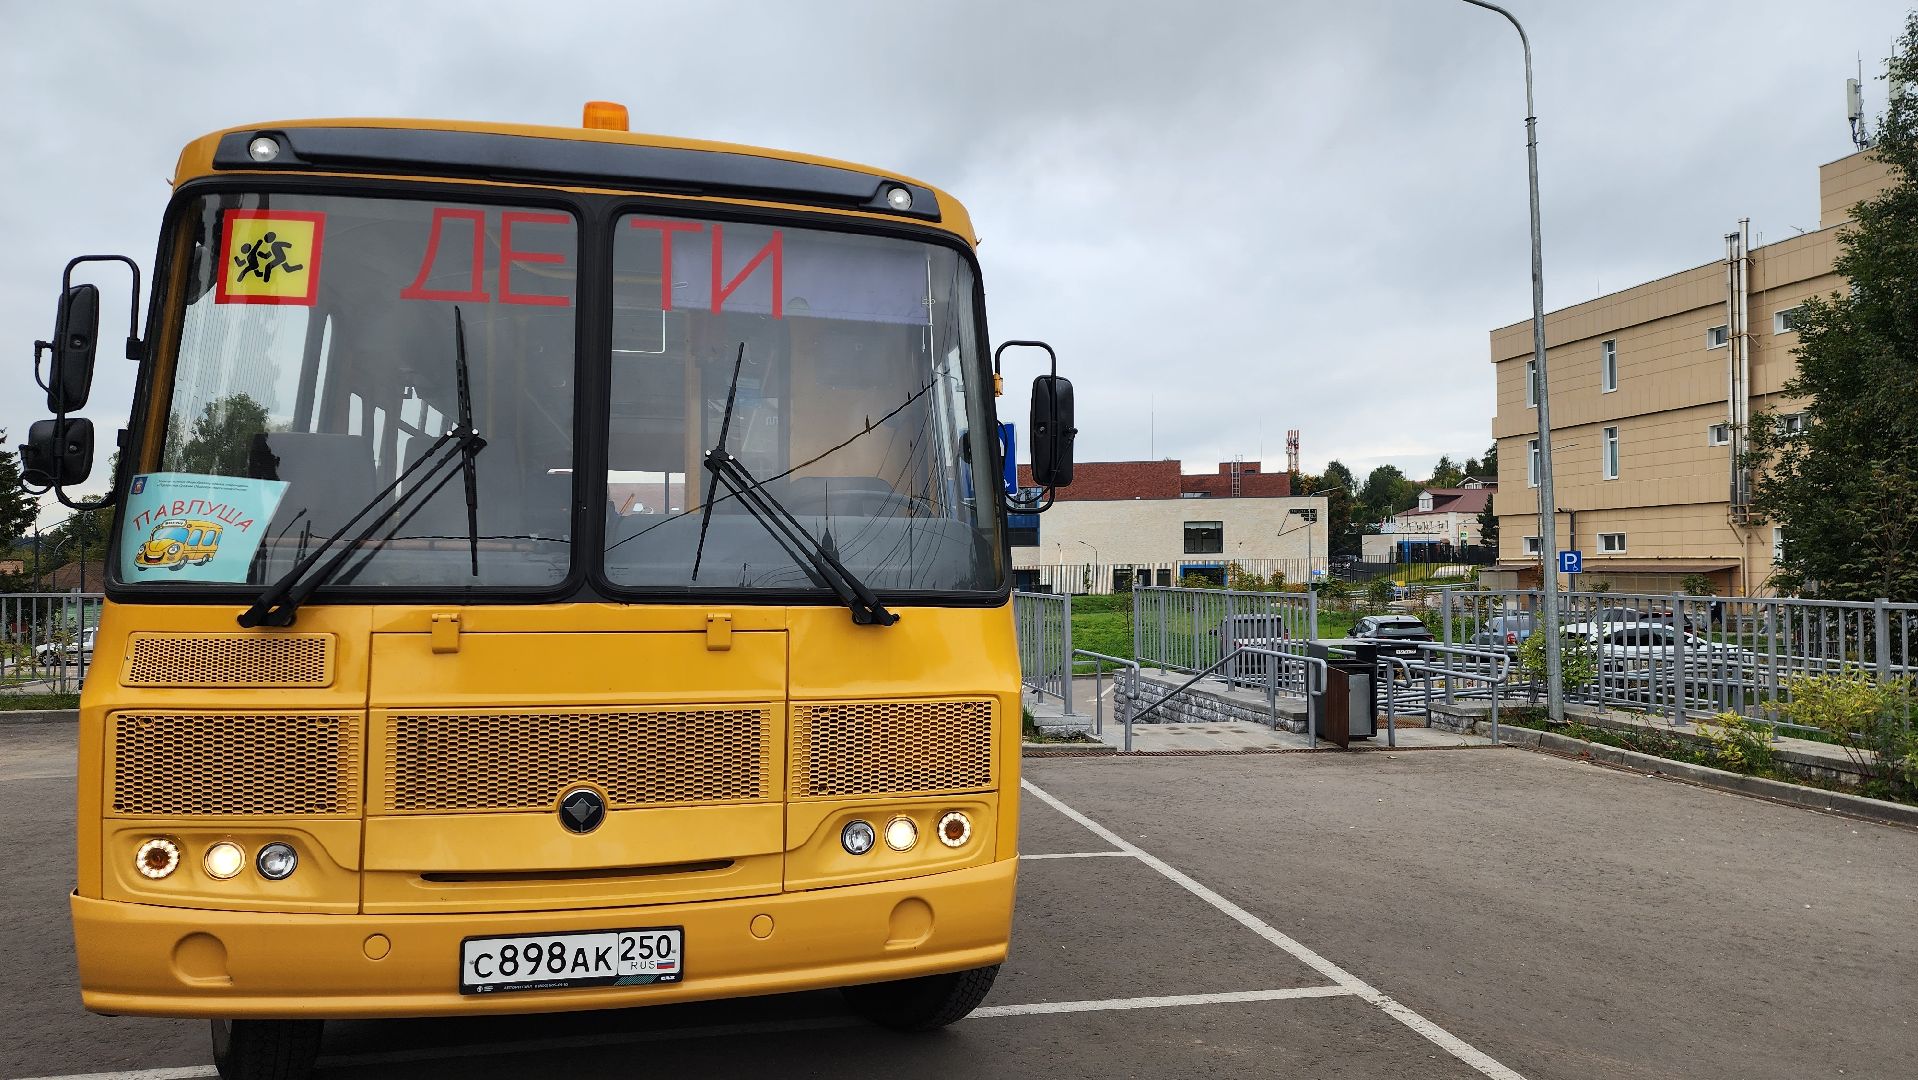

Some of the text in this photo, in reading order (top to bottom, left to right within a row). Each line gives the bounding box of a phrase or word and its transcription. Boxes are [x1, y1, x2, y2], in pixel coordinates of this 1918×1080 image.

[400, 207, 783, 320] ДЕТИ
[132, 499, 254, 533] ПАВЛУША
[1564, 553, 1578, 571] P
[620, 934, 673, 962] 250
[630, 960, 656, 970] RUS
